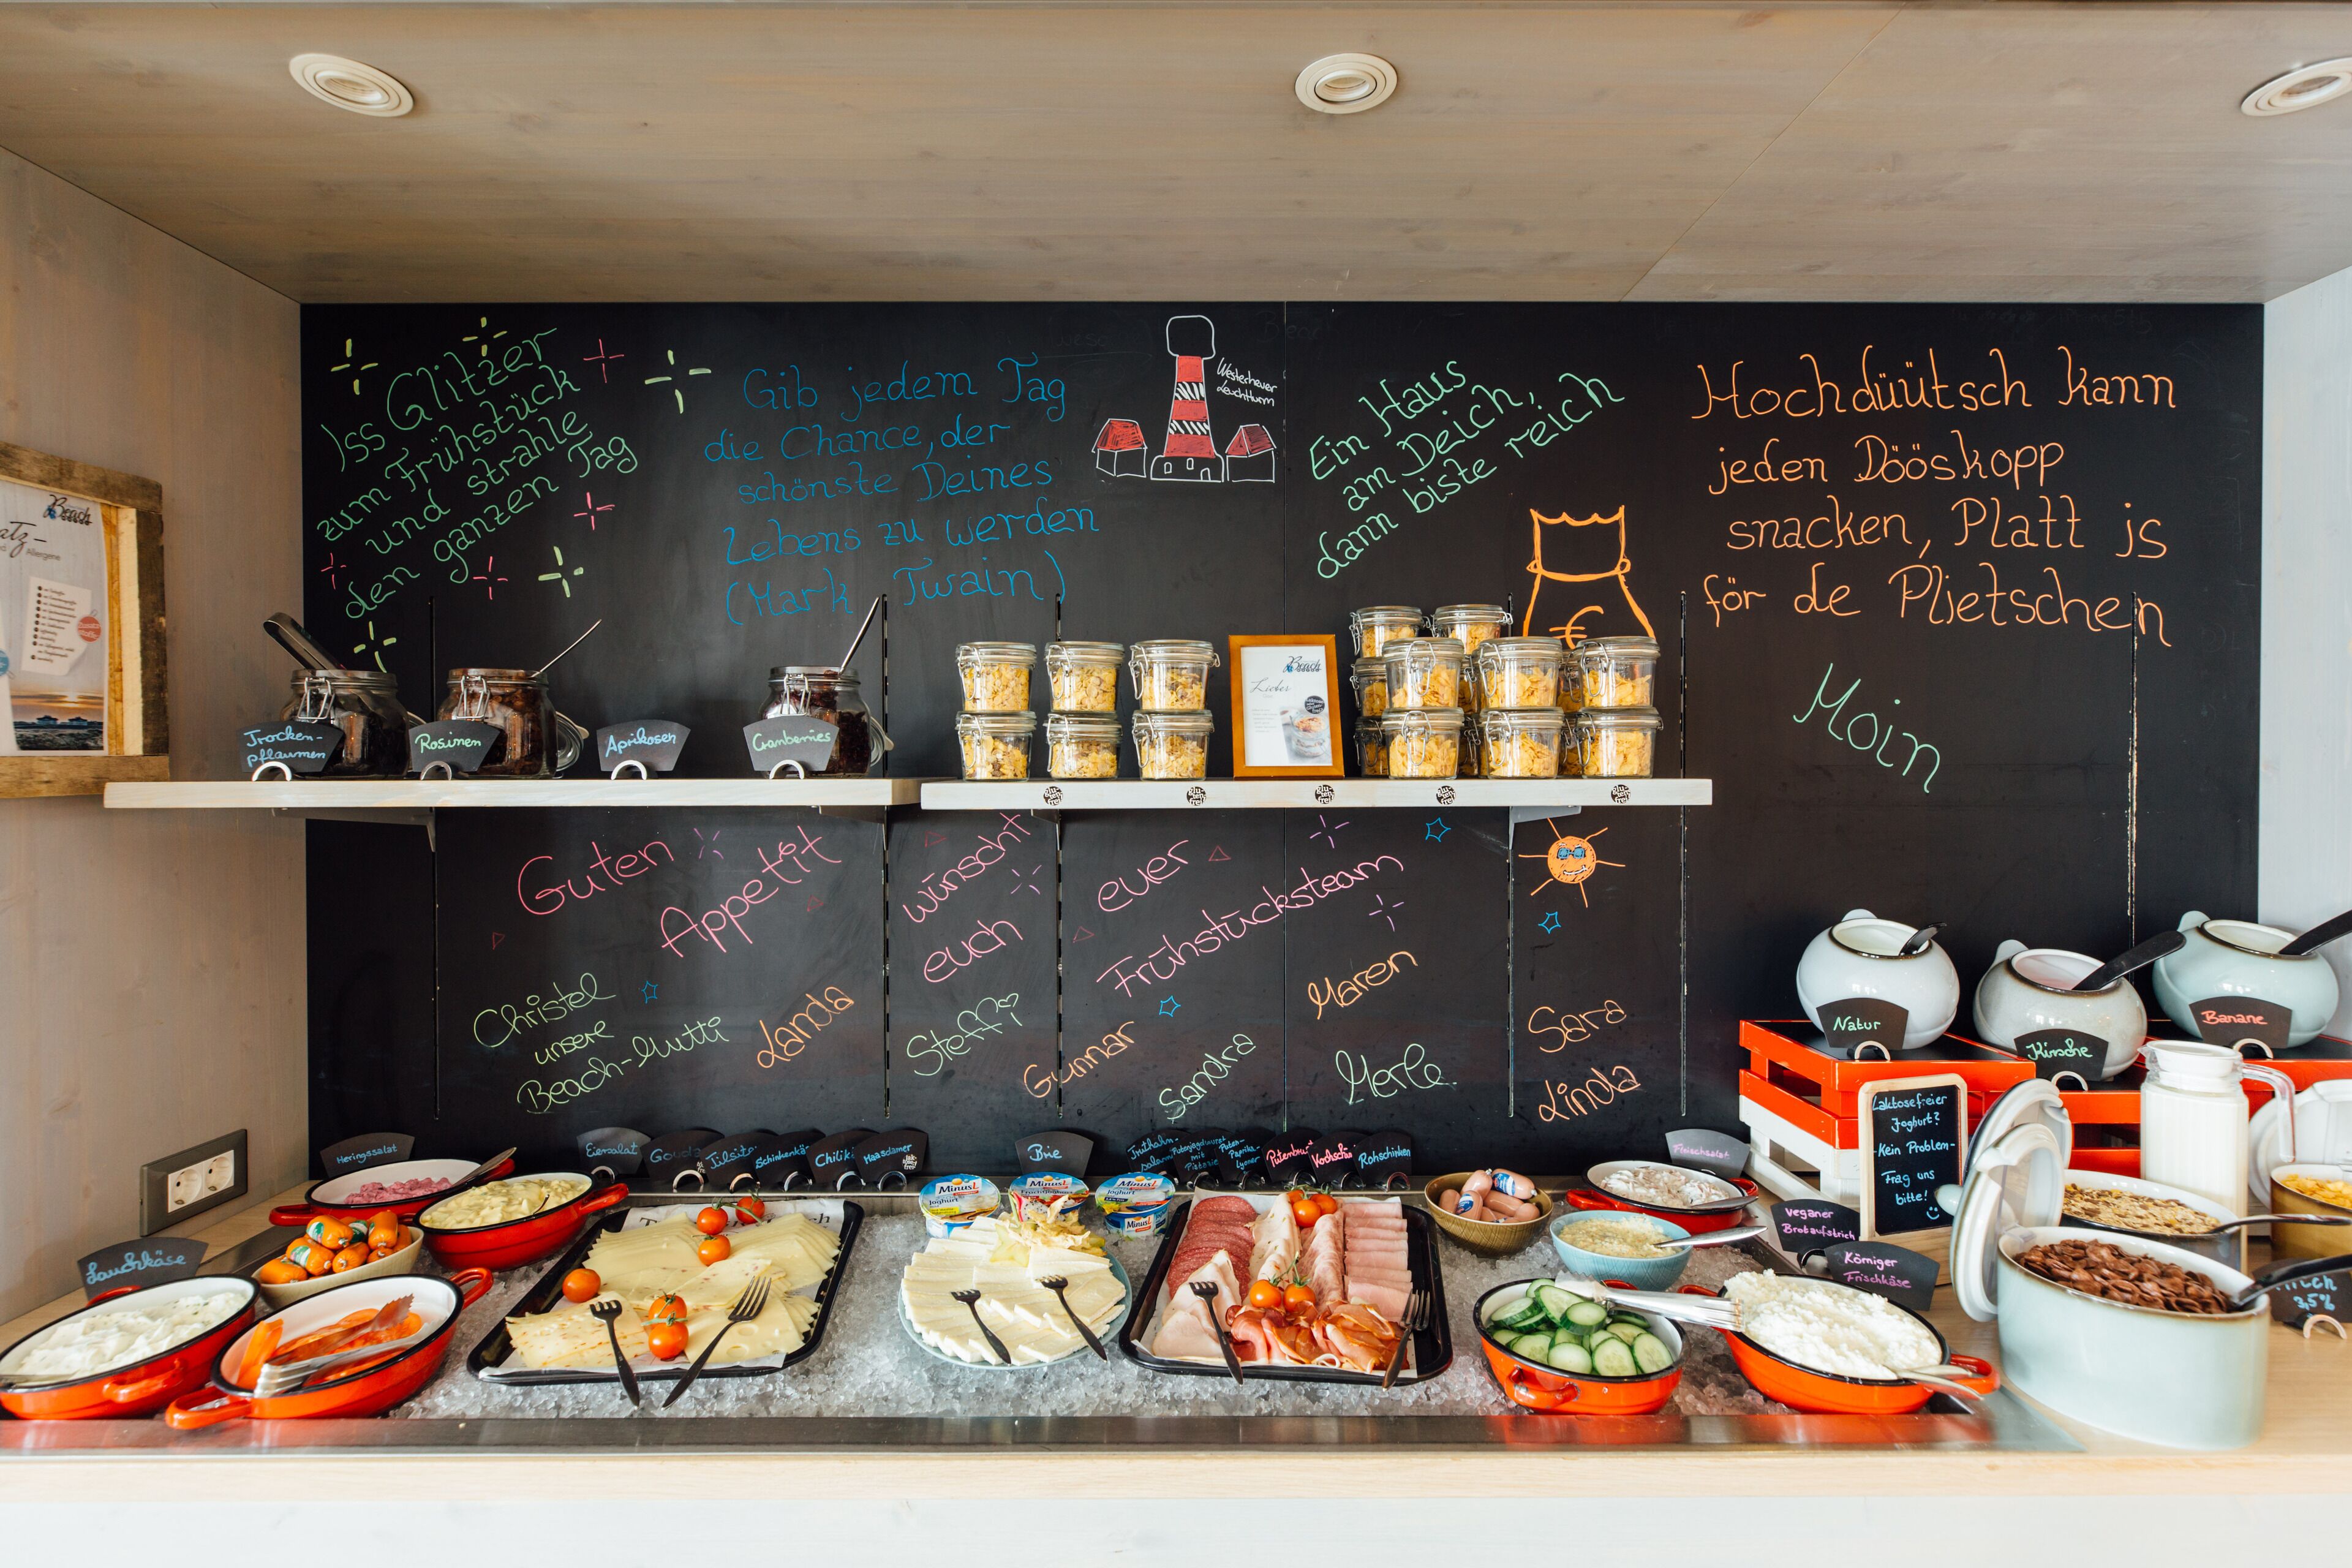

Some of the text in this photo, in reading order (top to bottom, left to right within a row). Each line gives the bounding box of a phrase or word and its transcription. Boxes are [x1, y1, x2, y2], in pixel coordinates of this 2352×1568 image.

[387, 328, 557, 430] Glitzer
[744, 352, 1065, 422] Gib jedem Tag
[1691, 345, 2176, 418] Hochdüütsch kann
[1310, 360, 1466, 480] Ein Haus
[705, 413, 1011, 461] die Chance, der
[1344, 385, 1540, 511] am Deich,
[317, 365, 580, 540] zum Frühstück
[1709, 430, 2064, 494] jeden Dööskopp
[366, 412, 588, 553] und strahle
[739, 455, 1052, 504] schönste Deines
[1317, 372, 1625, 579] dann biste reich
[347, 431, 638, 618] den ganzen Tag
[724, 497, 1099, 565] Lebens zu werden
[1727, 495, 1931, 558] snacken,
[1951, 495, 2084, 548] Platt
[726, 550, 1066, 625] (Mark Twain)
[1704, 575, 1766, 627] för
[1794, 562, 1861, 616] de
[1283, 656, 1322, 673] Beach
[1250, 677, 1291, 693] Lieber
[244, 726, 323, 748] Trocken-
[1793, 663, 1940, 793] Moin
[415, 733, 482, 753] Rosinen
[605, 727, 676, 758] Aprikosen
[752, 729, 832, 752] Cranberries
[247, 748, 326, 768] pflaumen
[1045, 787, 1060, 797] glu-
[1188, 786, 1204, 796] glu-
[1316, 785, 1332, 794] glu-
[1438, 786, 1452, 797] glu-
[1613, 785, 1628, 794] glu-
[518, 842, 674, 914] Guten
[903, 812, 1030, 922] wünscht
[1098, 840, 1188, 911] euer
[661, 826, 842, 957] Appetit
[1096, 855, 1404, 997] Frühstücksteam
[924, 920, 1023, 982] euch
[1308, 951, 1418, 1019] Maren
[473, 973, 617, 1048] Christel
[2201, 1010, 2268, 1025] Banane
[907, 993, 1022, 1076] Steffi
[1529, 1000, 1627, 1052] Sara
[1833, 1016, 1881, 1031] Natur
[535, 1020, 615, 1065] unsere
[2025, 1038, 2094, 1061] Kirsche
[1023, 1020, 1134, 1098] Gunnar
[1159, 1033, 1256, 1120] Sandra
[1336, 1043, 1457, 1105] Merle
[1539, 1066, 1641, 1121] Linda
[1872, 1093, 1948, 1111] Laktosefreier
[1891, 1112, 1940, 1133] Joghurt?
[336, 1144, 398, 1164] Heringssalat
[586, 1142, 638, 1157] Eiersalat
[706, 1145, 757, 1169] Tilsite
[815, 1146, 855, 1167] Chilik
[864, 1144, 912, 1164] Maasdamer
[1027, 1144, 1062, 1162] Brie
[1127, 1135, 1179, 1159] Truthahn-
[1191, 1152, 1205, 1161] mit
[1219, 1139, 1245, 1153] Puten-
[1228, 1145, 1261, 1159] Paprika-
[1359, 1145, 1411, 1169] Rohschinken
[1672, 1143, 1730, 1159] Fleischsalat
[1236, 1156, 1261, 1170] Lyoner
[939, 1182, 979, 1194] MinusL
[1881, 1170, 1936, 1188] Frag uns
[929, 1197, 959, 1206] Joghurt
[1895, 1190, 1928, 1205] bitte!
[1127, 1216, 1152, 1229] MinusL
[1781, 1223, 1855, 1240] Brotaufstrich
[86, 1250, 186, 1284] Lauchkäse
[1842, 1270, 1912, 1289] Frischkäse
